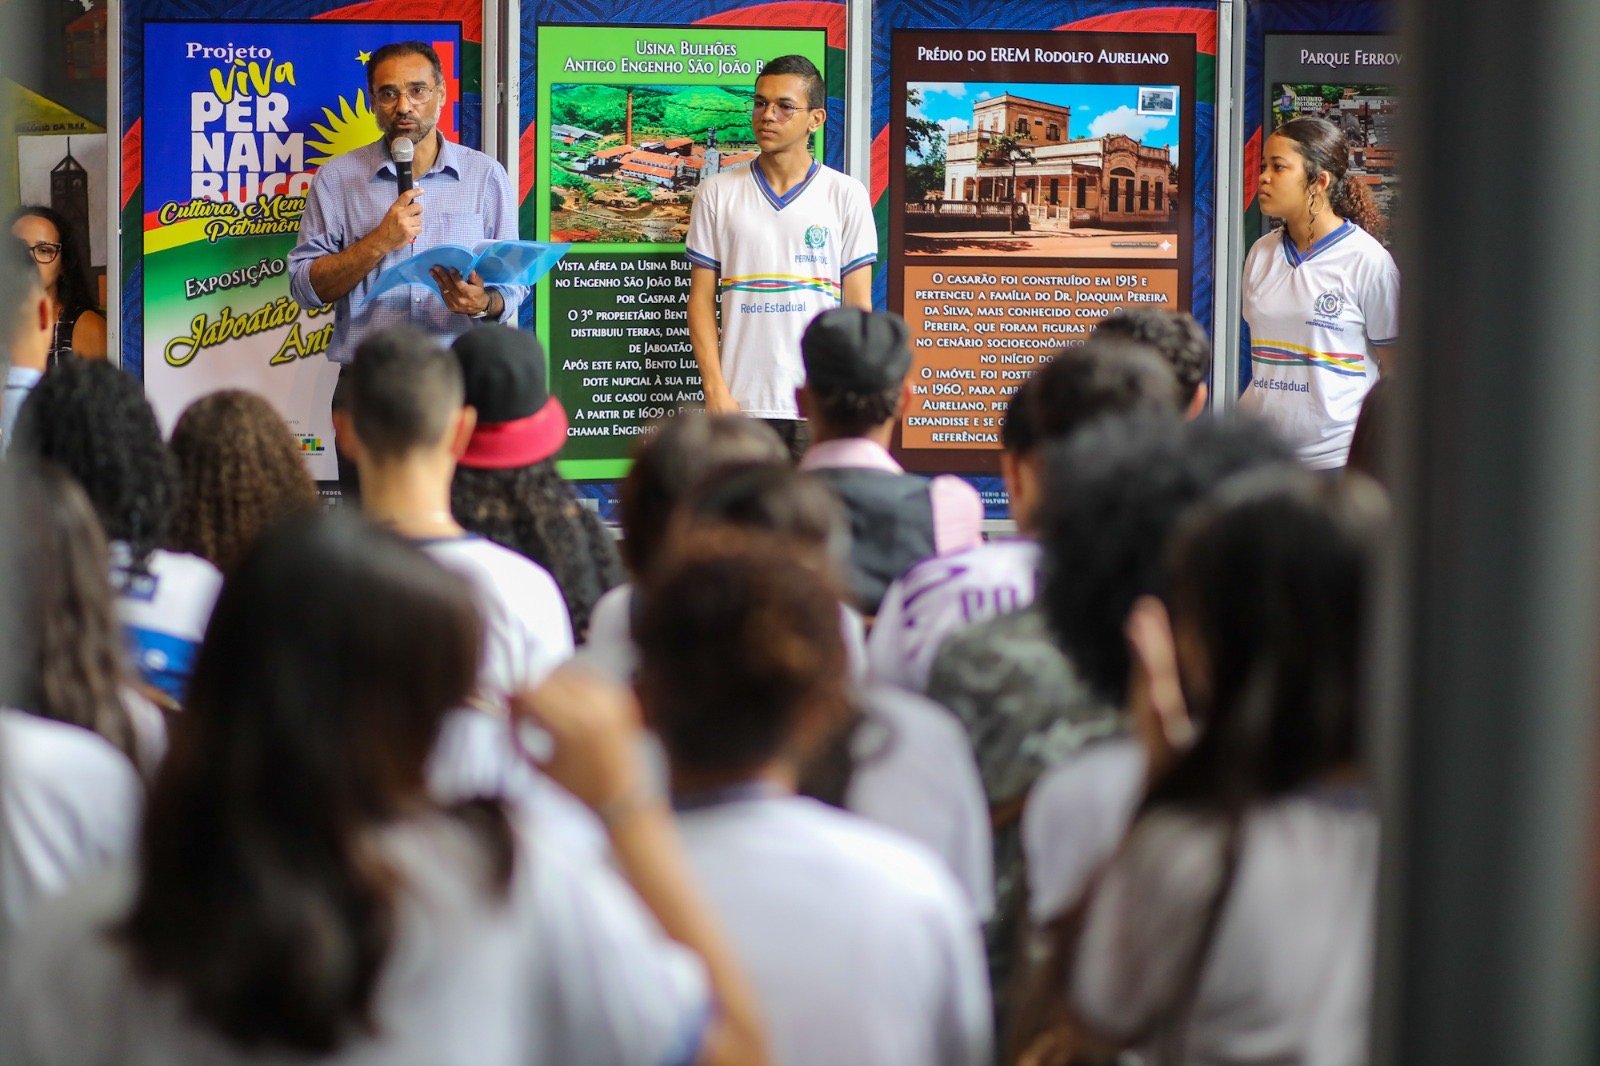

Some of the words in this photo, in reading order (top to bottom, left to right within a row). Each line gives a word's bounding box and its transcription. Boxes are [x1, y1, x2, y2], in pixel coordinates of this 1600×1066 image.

[185, 42, 272, 63] Projeto
[967, 49, 986, 62] DO
[990, 47, 1030, 63] EREM
[1034, 48, 1094, 63] RODOLFO
[1097, 49, 1169, 65] AURELIANO
[564, 57, 616, 73] ANTIGO
[621, 58, 683, 74] ENGENHO
[688, 58, 714, 75] SÃO
[717, 59, 751, 77] JOÃO
[191, 91, 290, 132] PER
[191, 132, 304, 172] NAM
[159, 198, 239, 225] Cultura,
[244, 194, 306, 221] Mem
[204, 216, 299, 244] Patrimôn
[557, 260, 585, 271] VISTA
[588, 260, 617, 271] AÉREA
[620, 262, 635, 271] DA
[638, 260, 667, 271] USINA
[184, 257, 285, 300] EXPOSIÇÃO
[555, 279, 571, 288] NO
[573, 277, 621, 288] ENGENHO
[624, 277, 644, 288] SÃO
[646, 277, 671, 290] JOÃO
[674, 276, 692, 287] BAT
[932, 273, 944, 284] O
[947, 274, 997, 285] CASARÃO
[1001, 275, 1018, 285] FOI
[1022, 274, 1091, 286] CONSTRUÍDO
[1095, 276, 1111, 286] EM
[1115, 275, 1138, 287] 1915
[1141, 277, 1148, 287] E
[616, 295, 635, 304] POR
[638, 293, 676, 304] GASPAR
[915, 291, 974, 300] PERTENCEU
[978, 291, 986, 300] A
[990, 289, 1031, 301] FAMÍLIA
[1035, 291, 1051, 301] DO
[1075, 291, 1124, 304] JOAQUIM
[1127, 291, 1169, 303] PEREIRA
[740, 303, 763, 314] Rede
[765, 301, 807, 313] Estadual
[924, 306, 940, 316] DA
[977, 307, 1004, 317] MAIS
[1007, 307, 1071, 317] CONHECIDO
[1075, 307, 1109, 318] COMO
[567, 310, 578, 321] O
[664, 309, 687, 320] BENT
[164, 296, 300, 368] Jaboatão
[571, 328, 623, 338] DISTRIBUIU
[626, 327, 663, 339] TERRAS,
[974, 323, 996, 334] QUE
[1000, 323, 1038, 333] FORAM
[1042, 323, 1085, 334] FIGURAS
[270, 322, 335, 367] Ant
[629, 345, 641, 353] DE
[644, 342, 693, 355] JABOATÃO
[916, 338, 933, 348] NO
[936, 336, 983, 348] CENÁRIO
[562, 359, 588, 370] APÓS
[592, 360, 612, 370] ESTE
[615, 360, 642, 371] FATO,
[645, 358, 676, 369] BENTO
[980, 354, 997, 364] NO
[1000, 352, 1035, 364] INÍCIO
[583, 377, 608, 386] DOTE
[612, 377, 651, 386] NUPCIAL
[654, 374, 662, 386] À
[665, 376, 682, 386] SUA
[921, 368, 932, 379] O
[936, 368, 976, 379] IMÓVEL
[980, 370, 998, 379] FOI
[932, 384, 965, 396] 1960,
[969, 386, 996, 395] PARA
[1253, 378, 1268, 389] ede
[1270, 379, 1309, 392] Estadual
[592, 394, 612, 403] QUE
[615, 393, 647, 403] CASOU
[650, 393, 673, 402] COM
[676, 390, 704, 402] ANTÔ
[922, 400, 987, 411] AURELIANO,
[991, 402, 1008, 411] PER
[575, 410, 584, 419] A
[587, 410, 620, 419] PARTIR
[623, 410, 635, 419] DE
[638, 407, 664, 419] 1609
[908, 417, 970, 427] EXPANDISSE
[973, 417, 979, 427] E
[983, 418, 994, 427] SE
[566, 427, 609, 437] CHAMAR
[932, 431, 998, 442] REFERÊNCIAS
